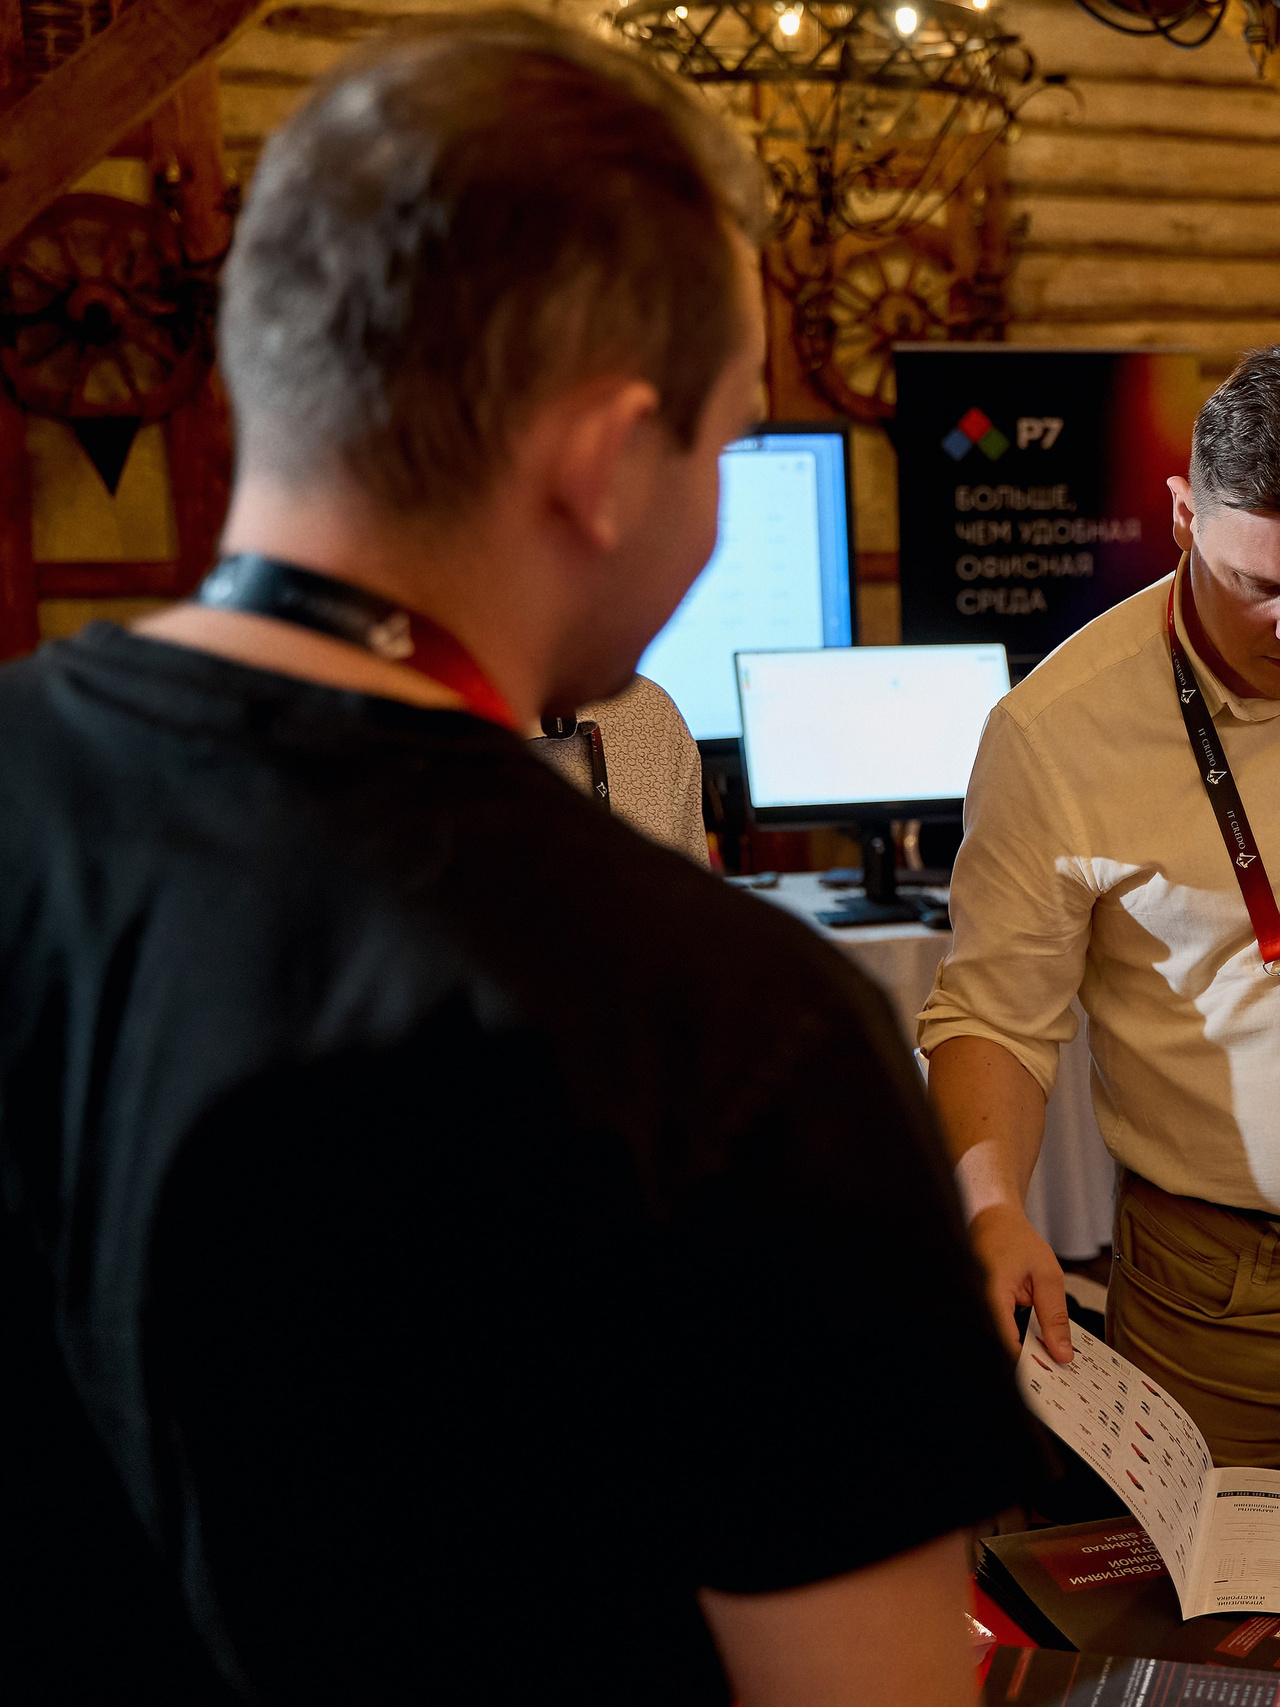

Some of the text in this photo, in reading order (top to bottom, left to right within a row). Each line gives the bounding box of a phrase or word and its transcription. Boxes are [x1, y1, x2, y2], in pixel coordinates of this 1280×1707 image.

[955, 485, 1077, 512] БОЛЬШЕ,
[955, 518, 1142, 547] ЧЕМ УДОБНАЯ
[955, 553, 1093, 580] ОФИСНАЯ
[955, 589, 1048, 615] СРЕДА
[1173, 658, 1186, 686] CREDO
[1198, 728, 1216, 767] IT CREDO
[1226, 810, 1246, 850] IT CREDO
[1081, 1539, 1139, 1554] KOMRAD
[1104, 1532, 1137, 1542] SIEM
[1069, 1562, 1161, 1585] СОБЫТИЯМИ
[1216, 1599, 1264, 1607] УПРАВЛЕНИЕ
